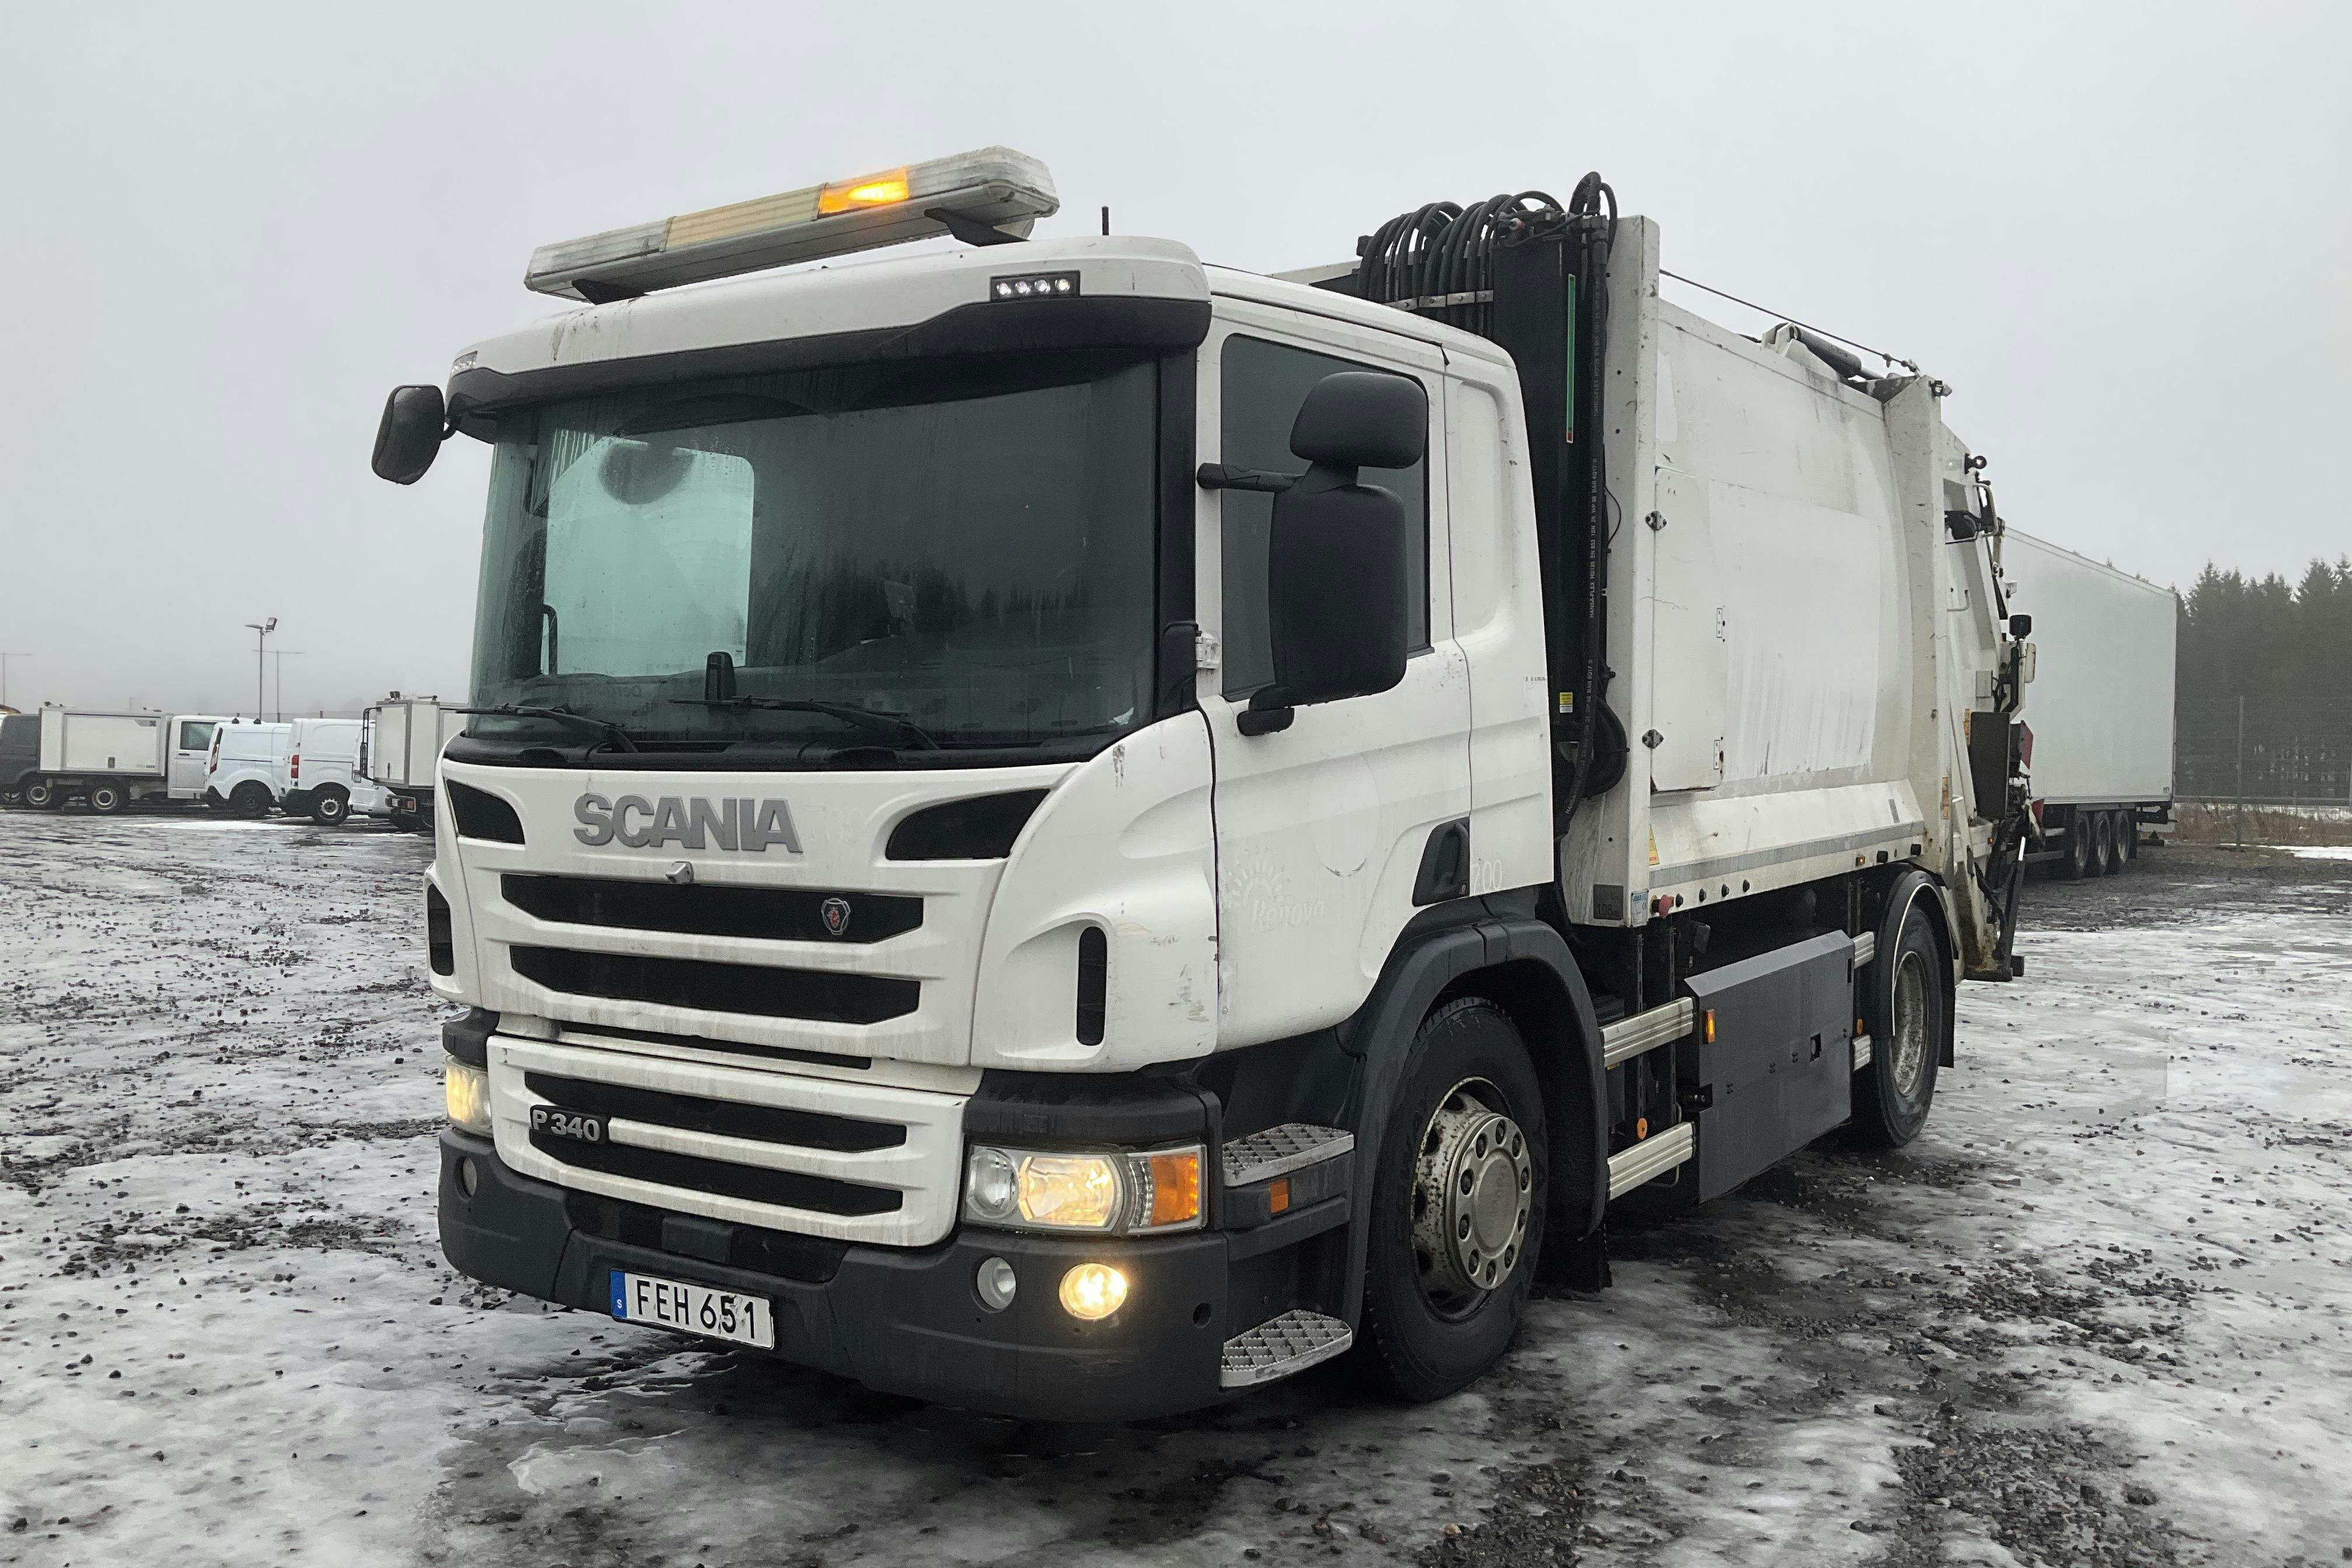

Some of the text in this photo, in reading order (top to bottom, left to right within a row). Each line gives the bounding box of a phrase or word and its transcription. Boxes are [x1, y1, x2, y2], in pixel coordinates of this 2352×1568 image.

[573, 792, 803, 853] SCANIA
[616, 1298, 622, 1309] S
[636, 1280, 755, 1339] FEH 651
